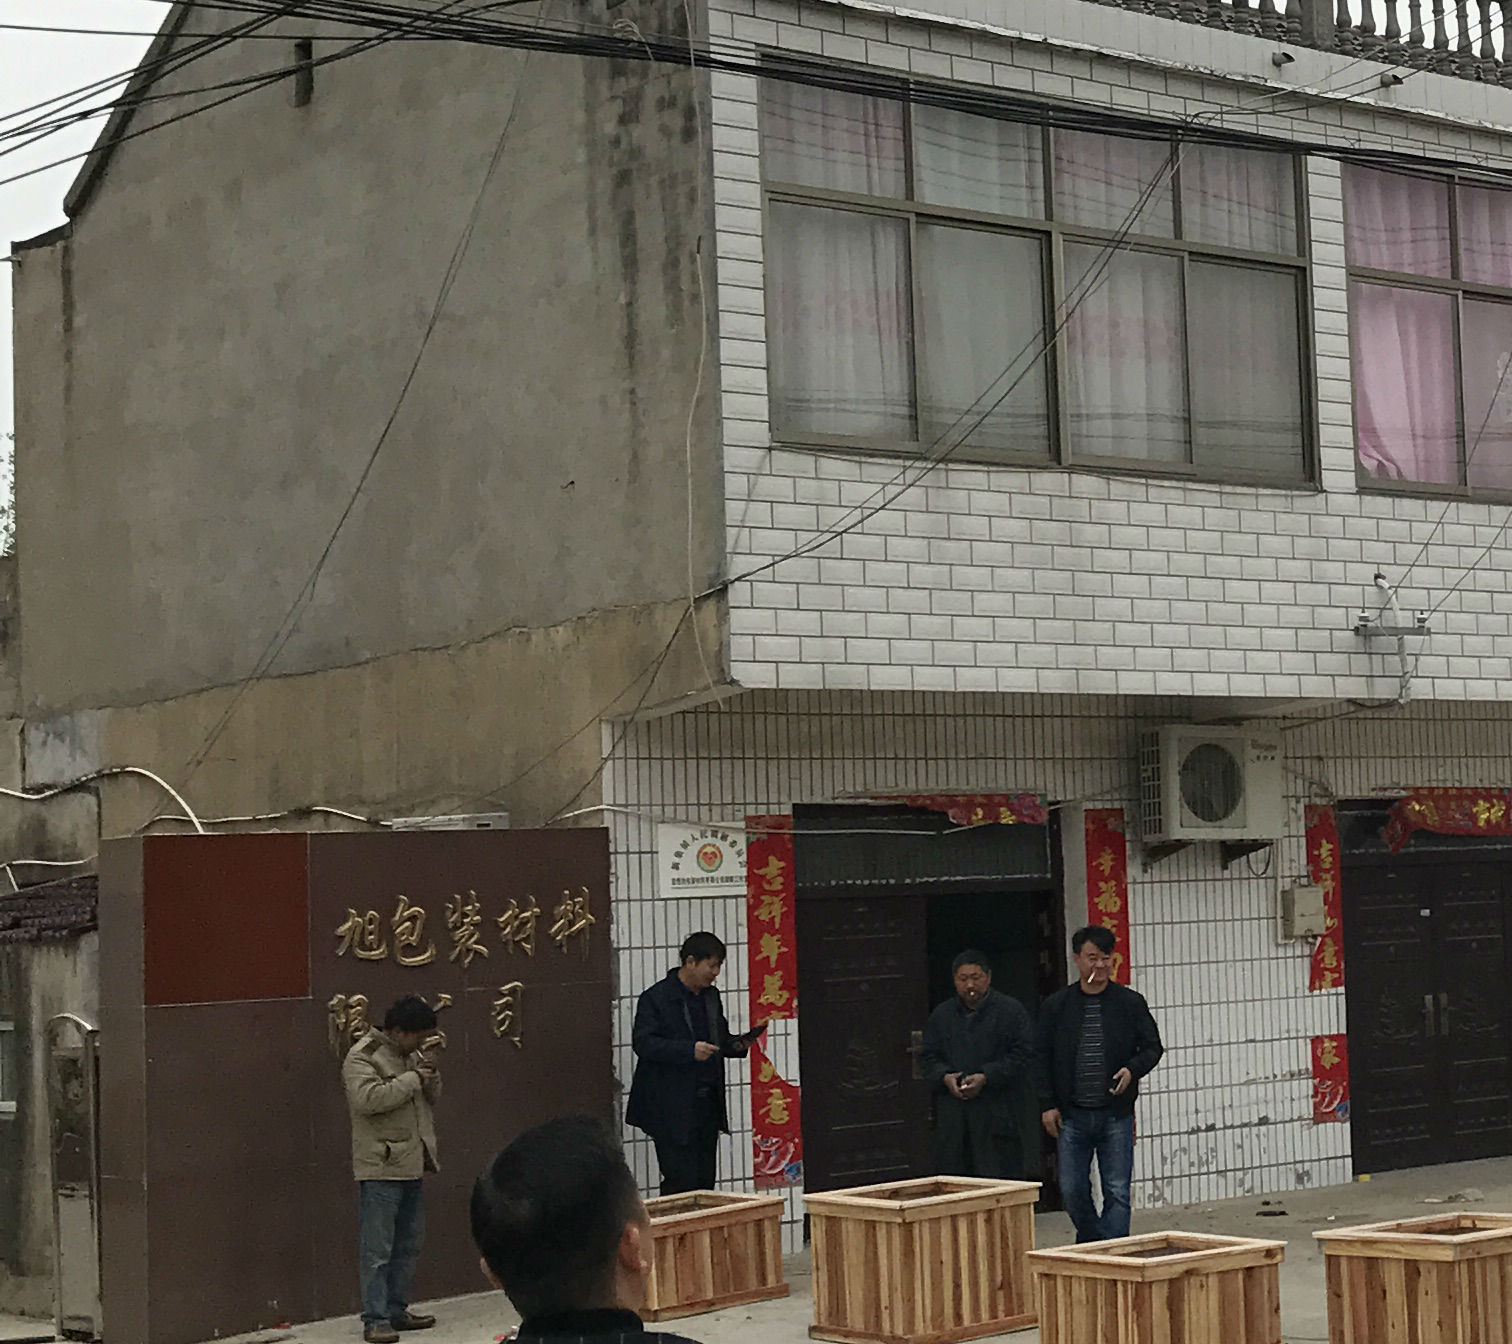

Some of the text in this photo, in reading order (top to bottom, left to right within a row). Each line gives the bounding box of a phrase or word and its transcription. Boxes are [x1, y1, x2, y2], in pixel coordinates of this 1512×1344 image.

[335, 886, 597, 968] 旭包装材料
